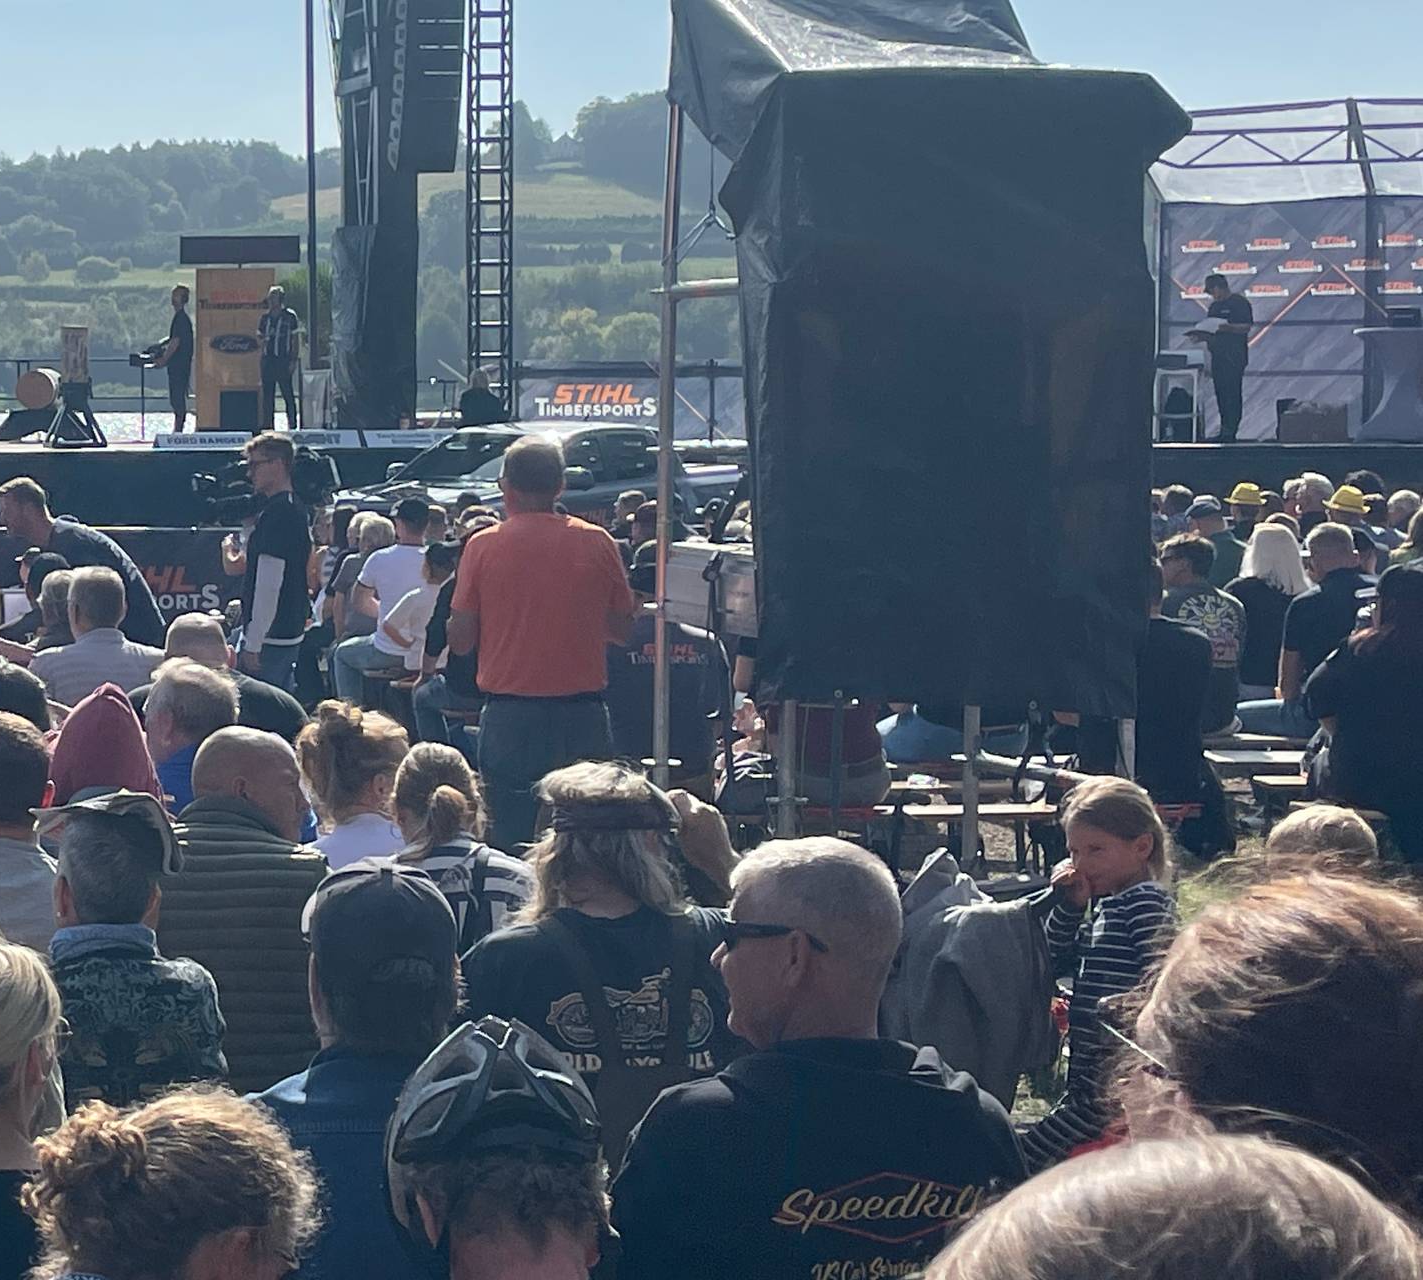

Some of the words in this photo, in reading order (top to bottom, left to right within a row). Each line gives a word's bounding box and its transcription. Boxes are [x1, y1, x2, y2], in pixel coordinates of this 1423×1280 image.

[553, 384, 640, 404] STIHL
[534, 396, 657, 417] TIMBERSPORTS
[153, 584, 220, 610] ORTS
